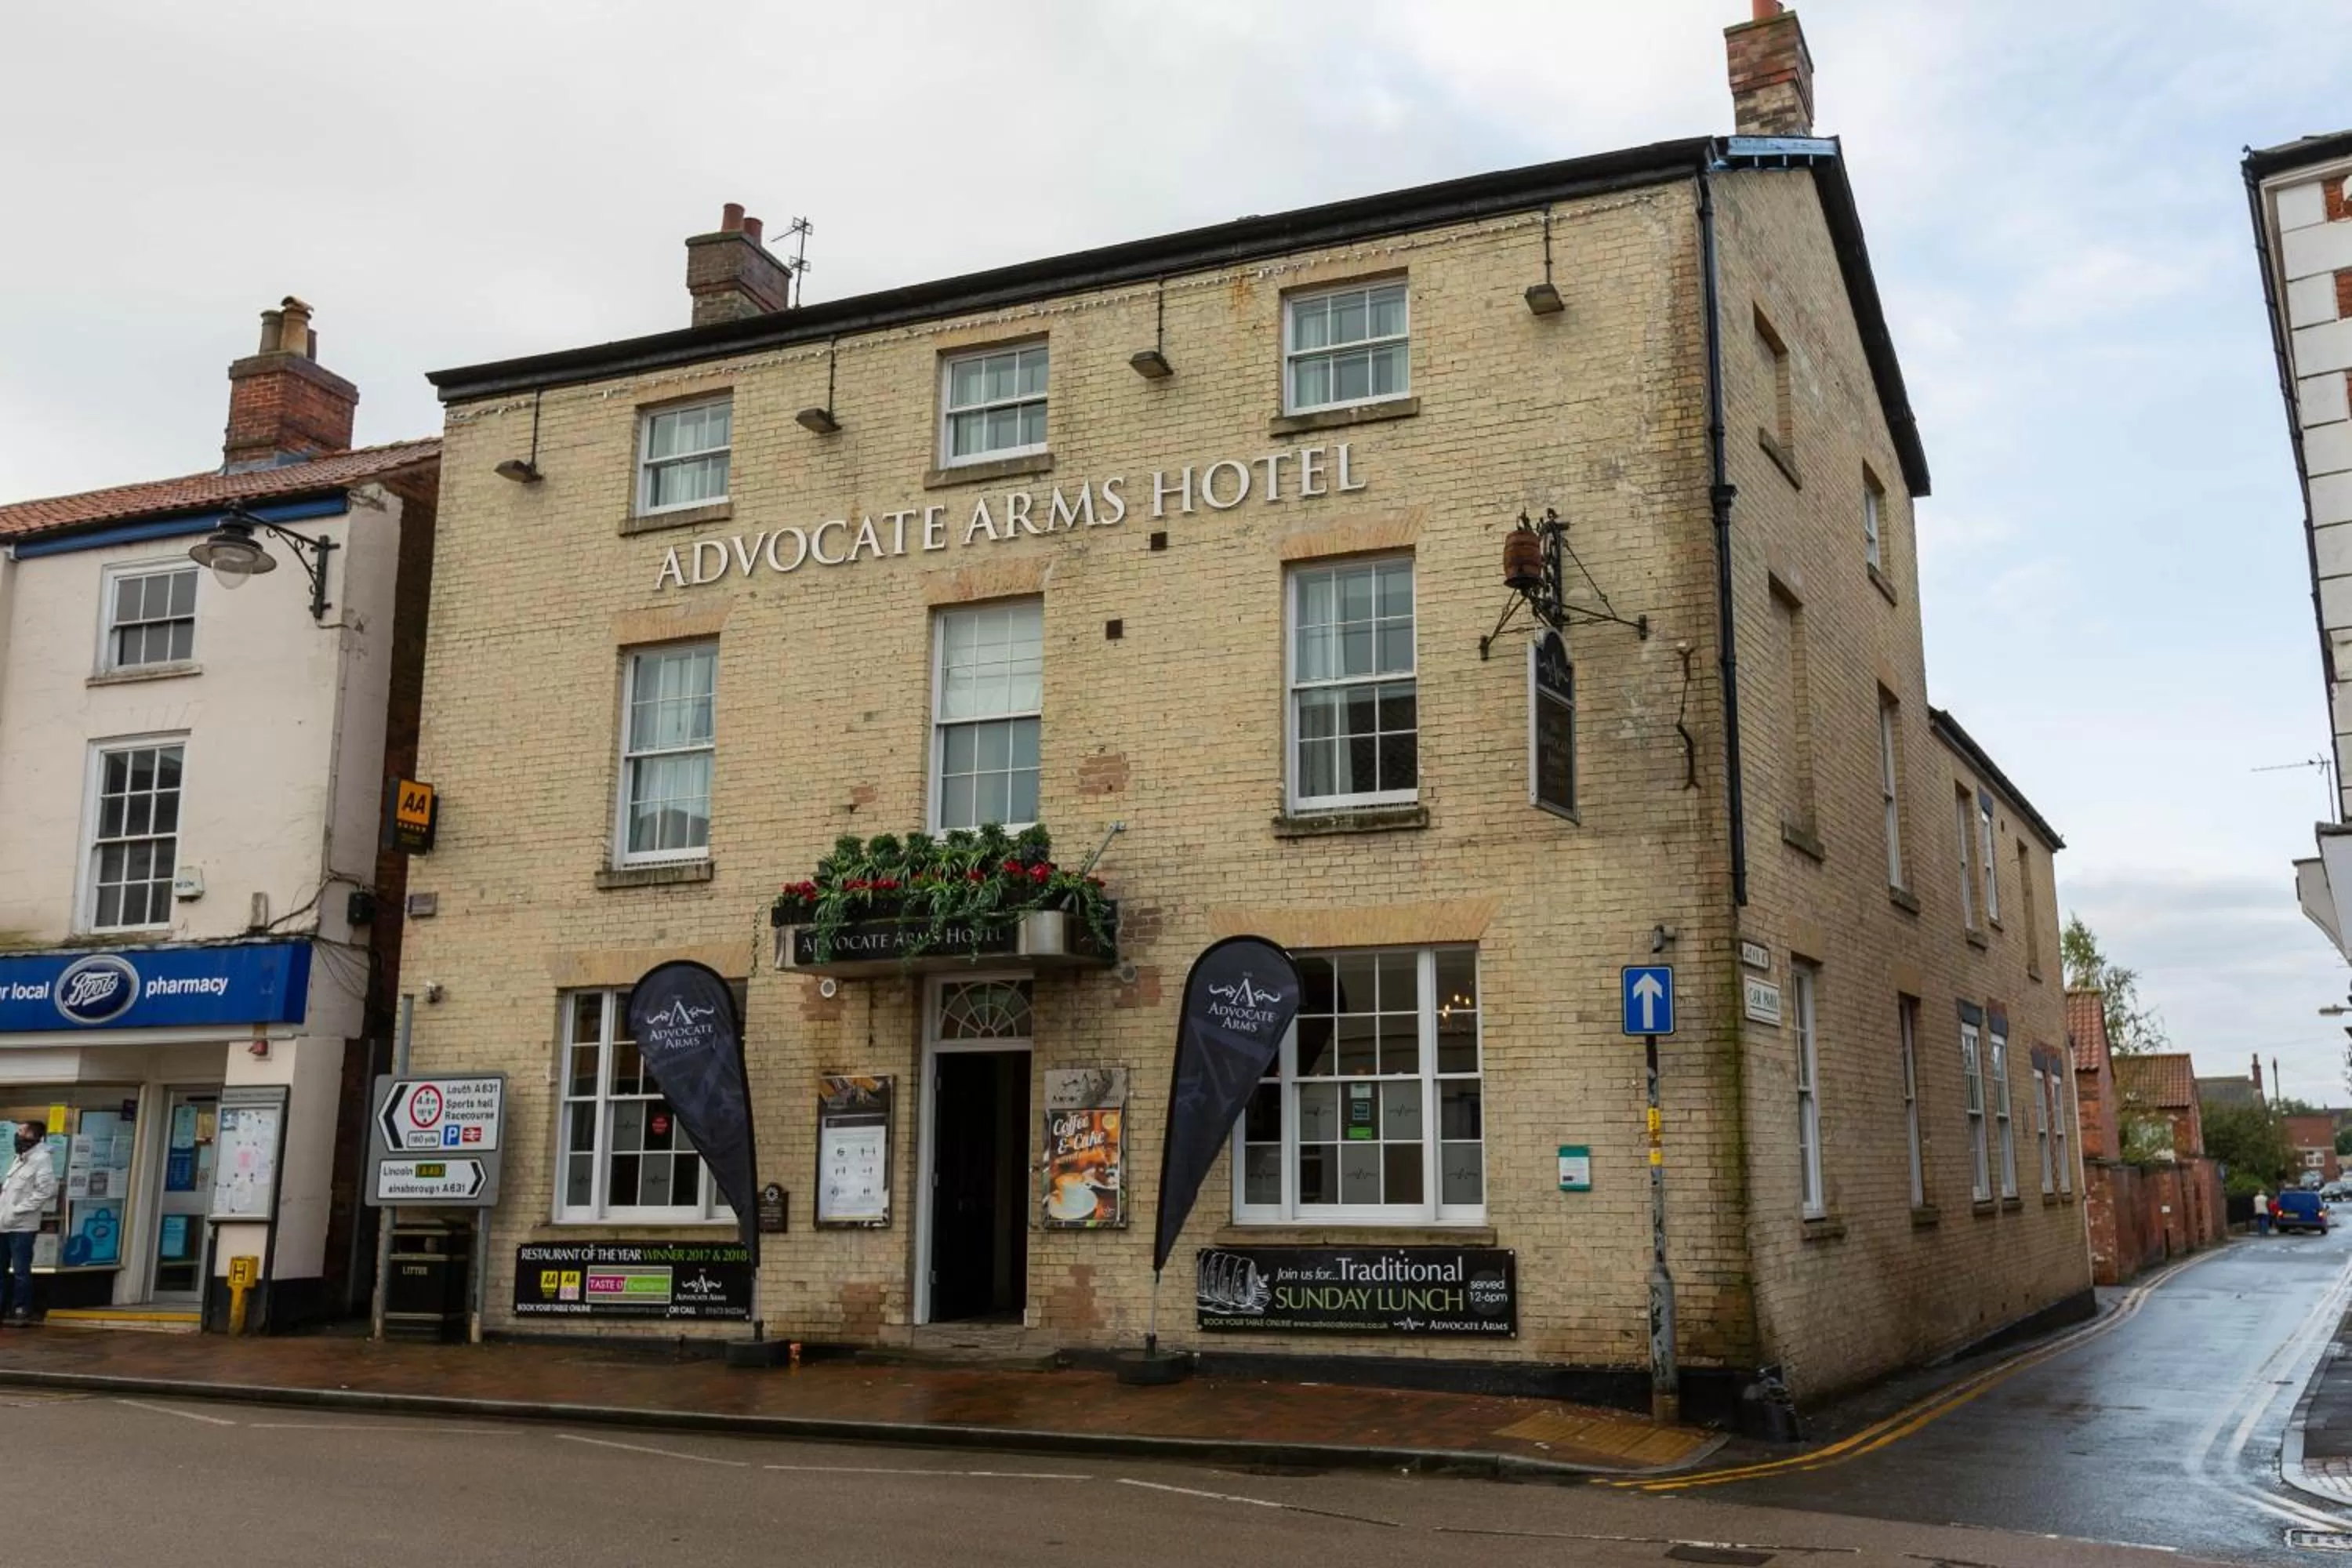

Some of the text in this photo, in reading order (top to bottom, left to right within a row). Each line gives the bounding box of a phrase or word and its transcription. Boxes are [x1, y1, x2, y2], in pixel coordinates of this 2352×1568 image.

[653, 442, 1368, 590] ADVOCATE ARMS HOTEL
[402, 791, 427, 814] AA
[11, 981, 50, 1000] local
[63, 971, 121, 1007] Boots
[146, 975, 229, 999] pharmacy
[1207, 1002, 1276, 1022] ADVOCATE
[1221, 1016, 1259, 1033] ARMS
[650, 1024, 713, 1041] ADVOCATE
[665, 1036, 700, 1050] ARMS
[446, 1084, 471, 1094] Louth
[445, 1098, 493, 1109] Sports hall
[445, 1111, 495, 1120] Racecourse
[1053, 1114, 1090, 1137] Coffee
[447, 1126, 459, 1145] P
[1074, 1131, 1105, 1150] Cake
[383, 1166, 413, 1176] Lincoln
[442, 1182, 465, 1192] A631
[521, 1248, 579, 1261] RESTAURANT
[581, 1248, 596, 1261] OF
[597, 1248, 616, 1261] THE
[618, 1248, 641, 1261] YEAR
[643, 1249, 684, 1261] WINNER
[685, 1249, 709, 1261] 2017
[722, 1249, 747, 1261] 2018
[233, 1263, 246, 1280] H
[1276, 1267, 1298, 1281] Join
[1301, 1269, 1313, 1279] us
[1335, 1255, 1463, 1281] Traditional
[543, 1273, 576, 1284] AA AA
[590, 1279, 615, 1290] TASTE
[1470, 1279, 1505, 1290] served
[1275, 1287, 1464, 1311] SUNDAY LUNCH
[1468, 1292, 1508, 1302] 12-6pm
[1204, 1318, 1226, 1327] BOOK
[1429, 1320, 1508, 1330] ADVOCATE ARMS
